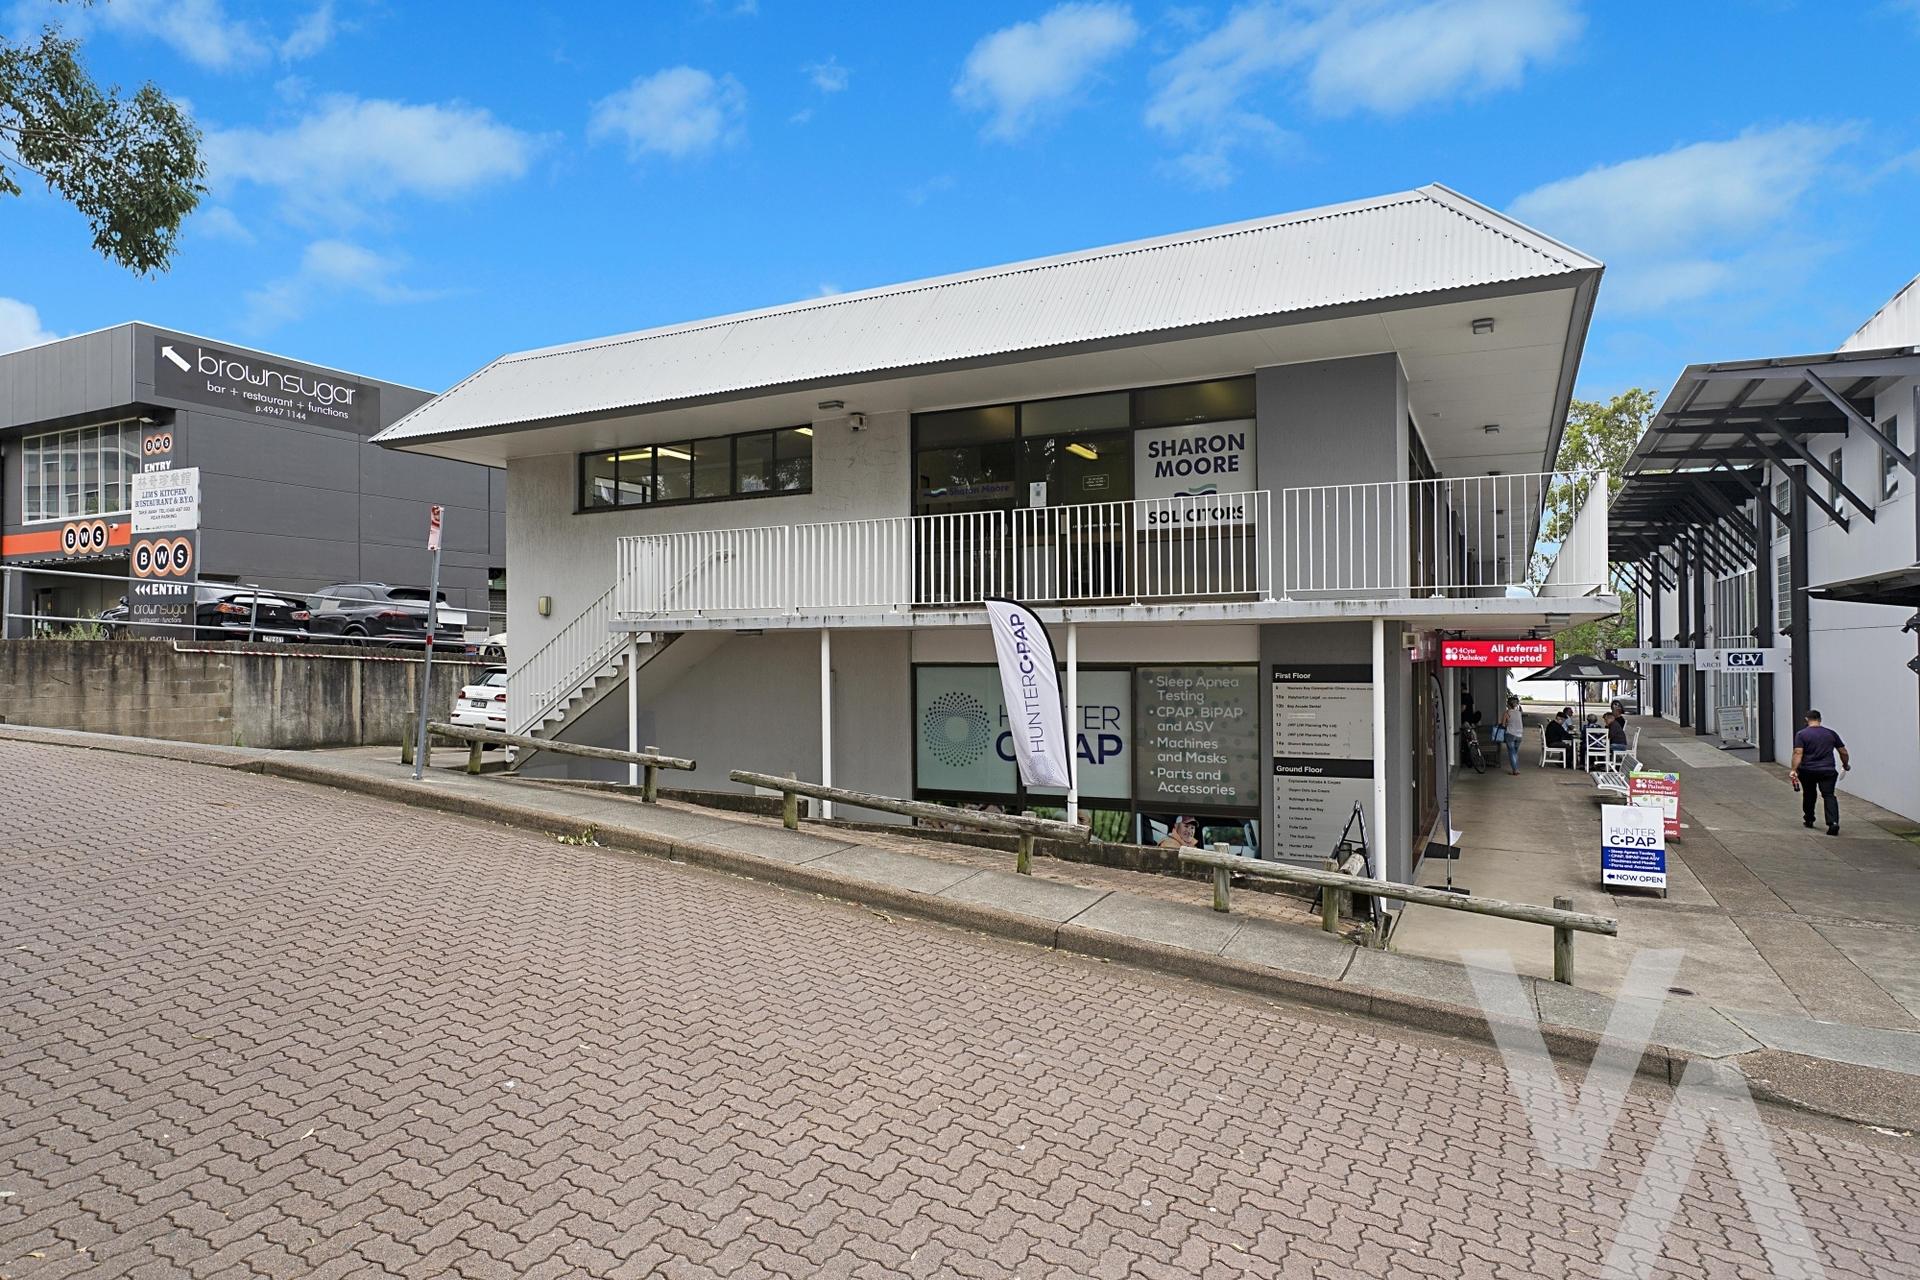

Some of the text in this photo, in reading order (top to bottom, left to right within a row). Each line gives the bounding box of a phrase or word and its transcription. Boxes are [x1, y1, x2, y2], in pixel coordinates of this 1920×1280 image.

[198, 348, 356, 405] brownsugar
[207, 381, 226, 394] bar
[243, 391, 293, 408] restaurant
[308, 402, 349, 419] functions
[255, 404, 306, 420] p.4947 1144
[1148, 433, 1245, 458] SHARON
[144, 461, 171, 473] ENTRY
[1155, 455, 1239, 478] MOORE
[160, 488, 187, 497] KITCHEN
[135, 498, 173, 507] RESTAURANT
[152, 583, 188, 595] ENTRY
[1490, 644, 1504, 652] All
[1506, 644, 1547, 652] referrals
[1498, 654, 1542, 664] accepted
[1729, 654, 1762, 665] GPV
[1156, 676, 1239, 689] Sleep Apnea
[1157, 690, 1204, 705] Testing
[1200, 707, 1243, 718] BiPAP
[1157, 721, 1214, 732] and ASV
[1157, 736, 1218, 749] Machines
[1157, 752, 1227, 764] and Masks
[1157, 768, 1221, 780] Parts and
[1158, 782, 1236, 796] Accessories
[1610, 827, 1655, 836] HUNTER
